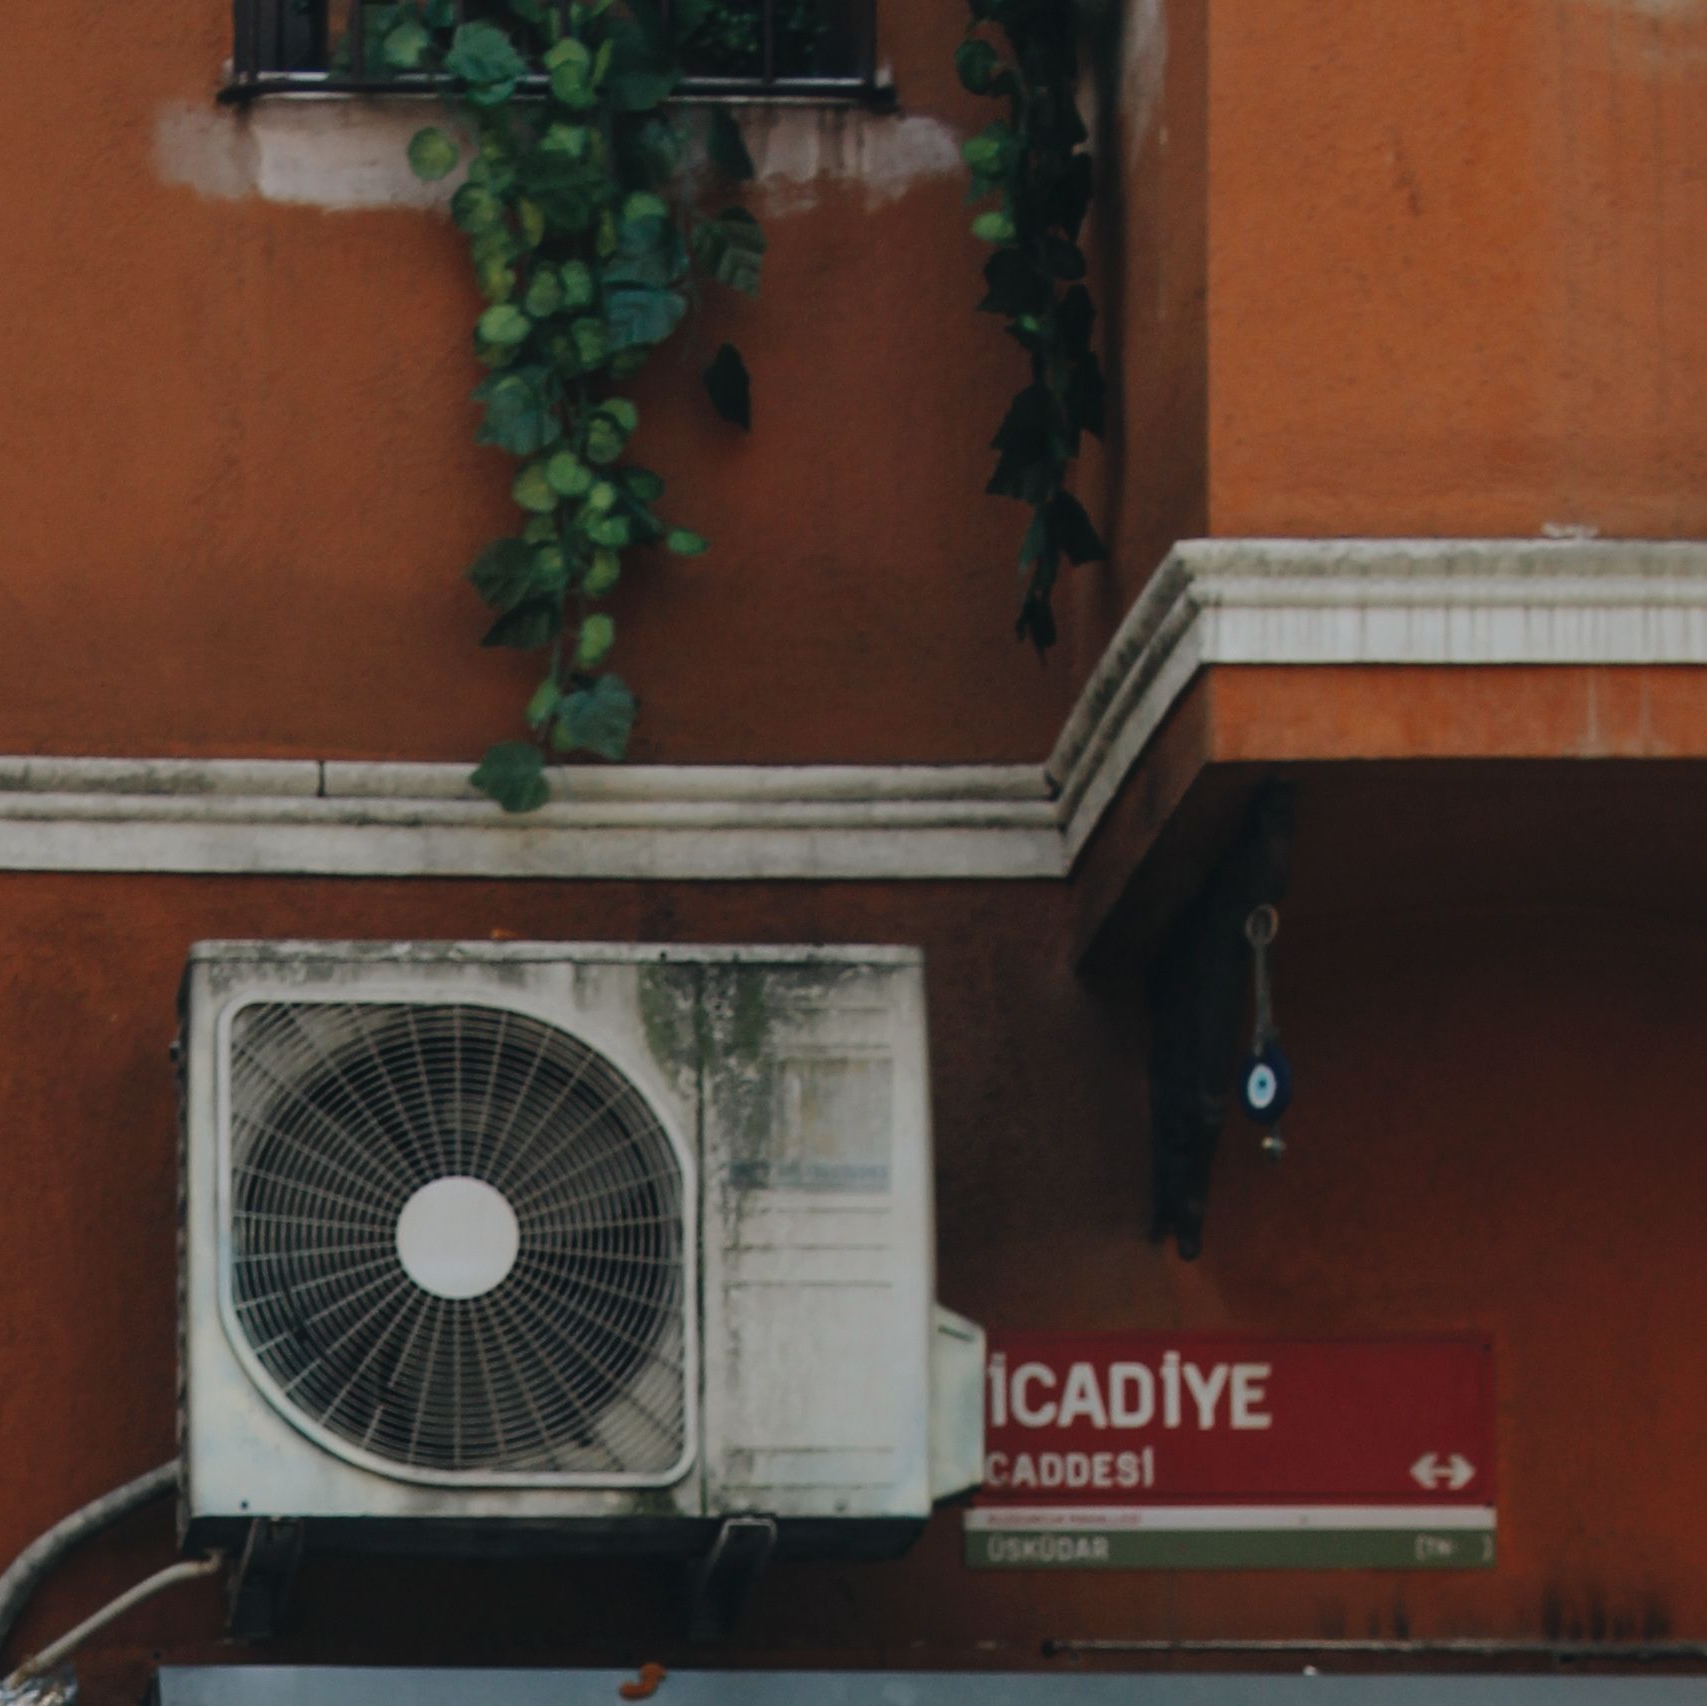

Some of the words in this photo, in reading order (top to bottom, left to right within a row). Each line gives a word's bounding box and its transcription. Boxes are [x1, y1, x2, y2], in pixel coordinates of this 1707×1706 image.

[988, 1350, 1273, 1431] İCADİYE
[986, 1446, 1154, 1489] CADDESİ
[986, 1532, 1110, 1563] ÜSKÜDAR
